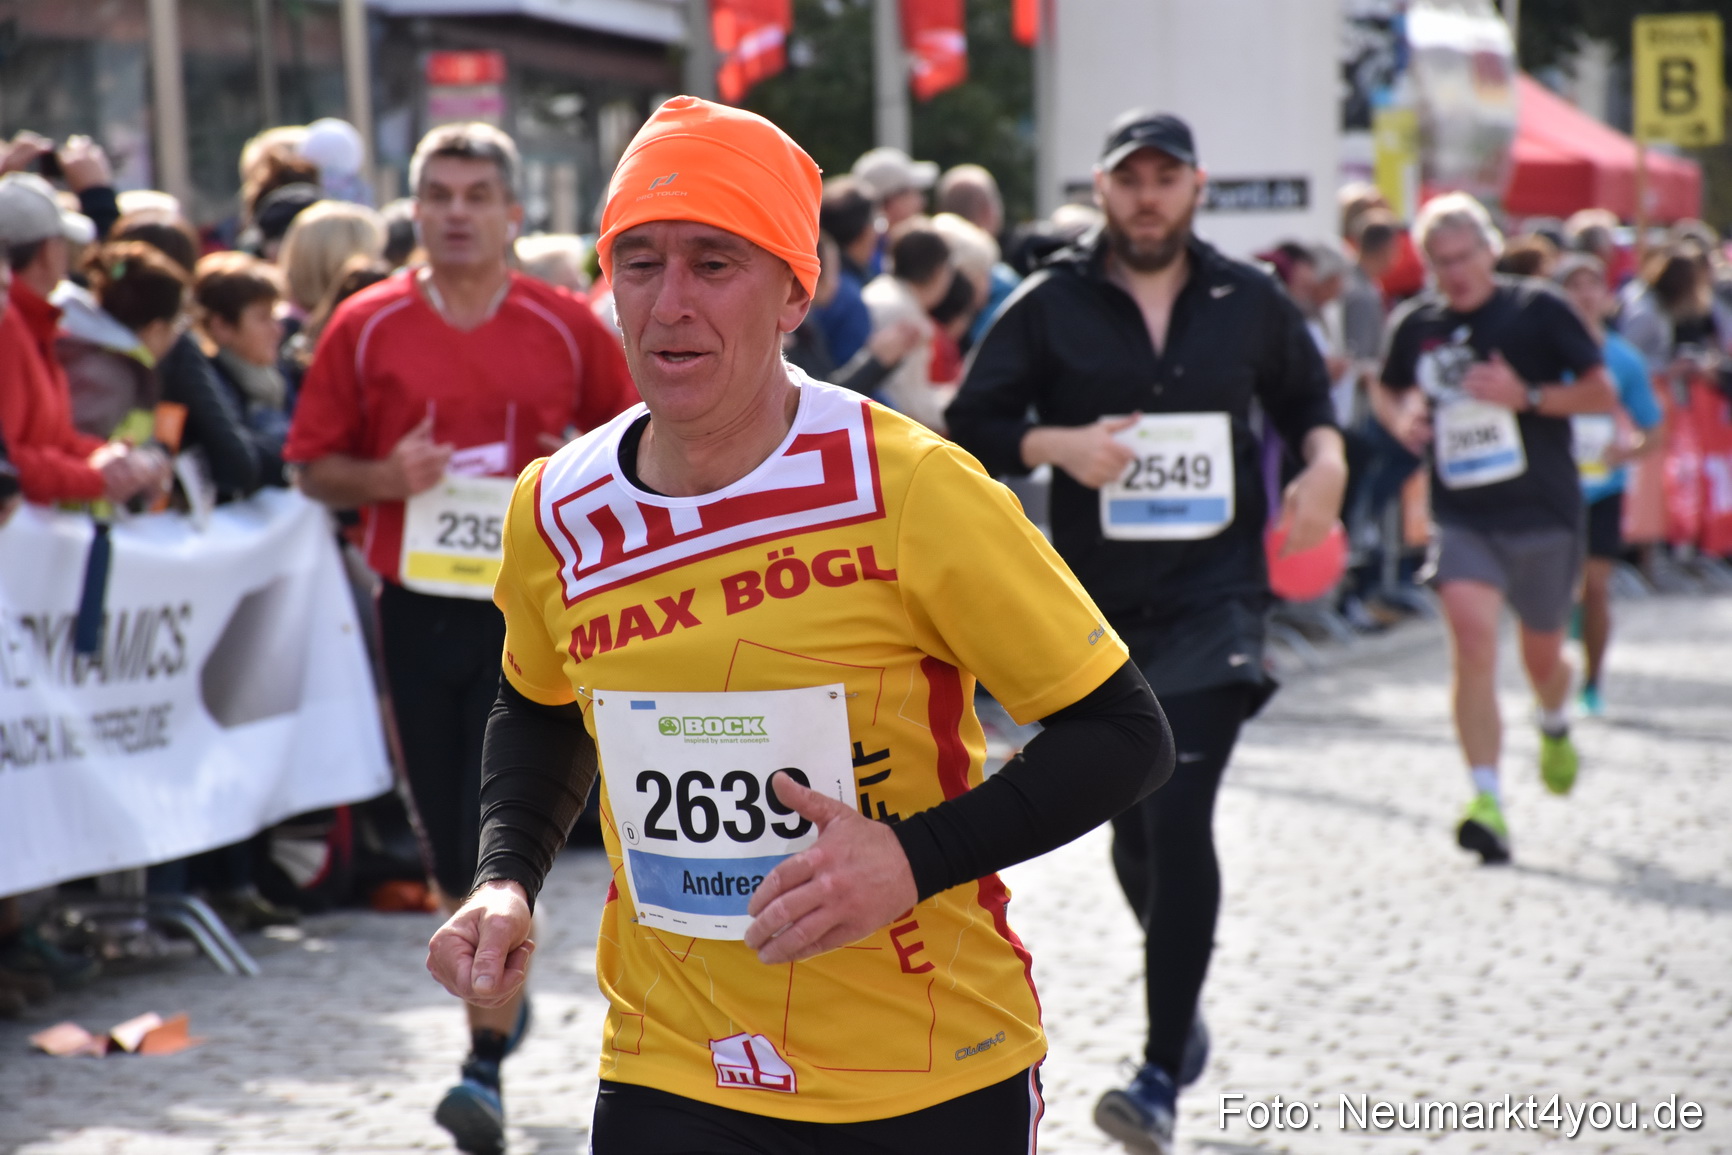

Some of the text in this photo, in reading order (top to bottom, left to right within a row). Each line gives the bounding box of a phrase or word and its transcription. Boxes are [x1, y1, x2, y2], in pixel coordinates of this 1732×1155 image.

[1658, 57, 1699, 116] B
[1123, 454, 1212, 490] 2549
[567, 545, 898, 665] MAX BÖGL
[682, 716, 768, 736] BOCK
[684, 736, 709, 744] inspired
[711, 736, 718, 745] by
[740, 736, 770, 744] concepts
[636, 767, 813, 843] 2639
